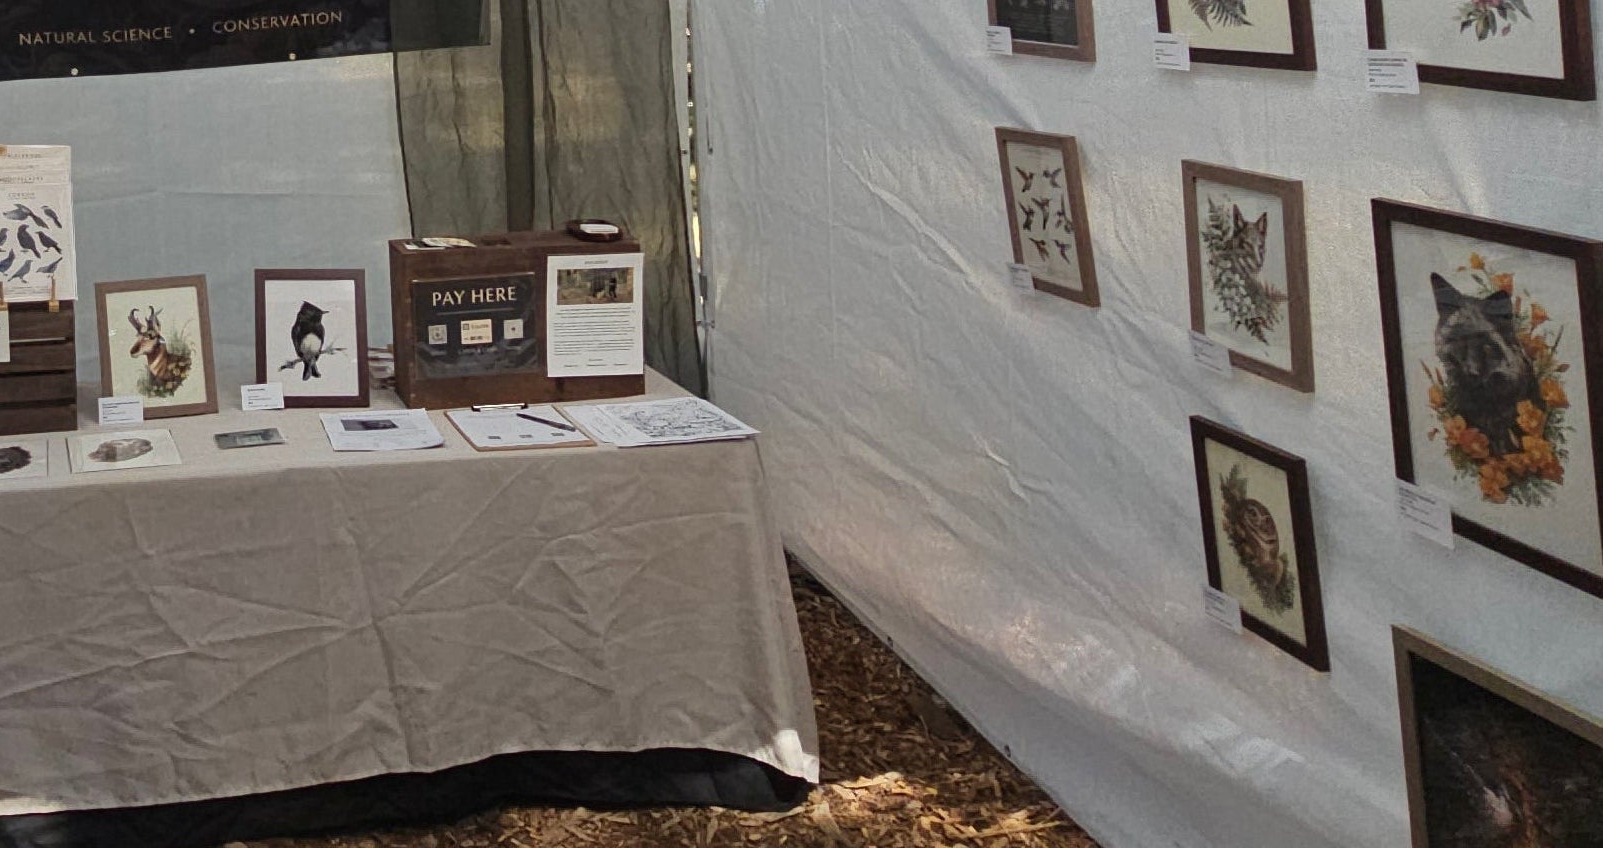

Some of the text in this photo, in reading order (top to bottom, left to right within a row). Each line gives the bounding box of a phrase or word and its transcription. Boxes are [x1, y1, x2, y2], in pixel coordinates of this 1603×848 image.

[18, 10, 343, 46] NATURAL SCIENCE CONSERVATION
[432, 286, 517, 307] PAY HERE
